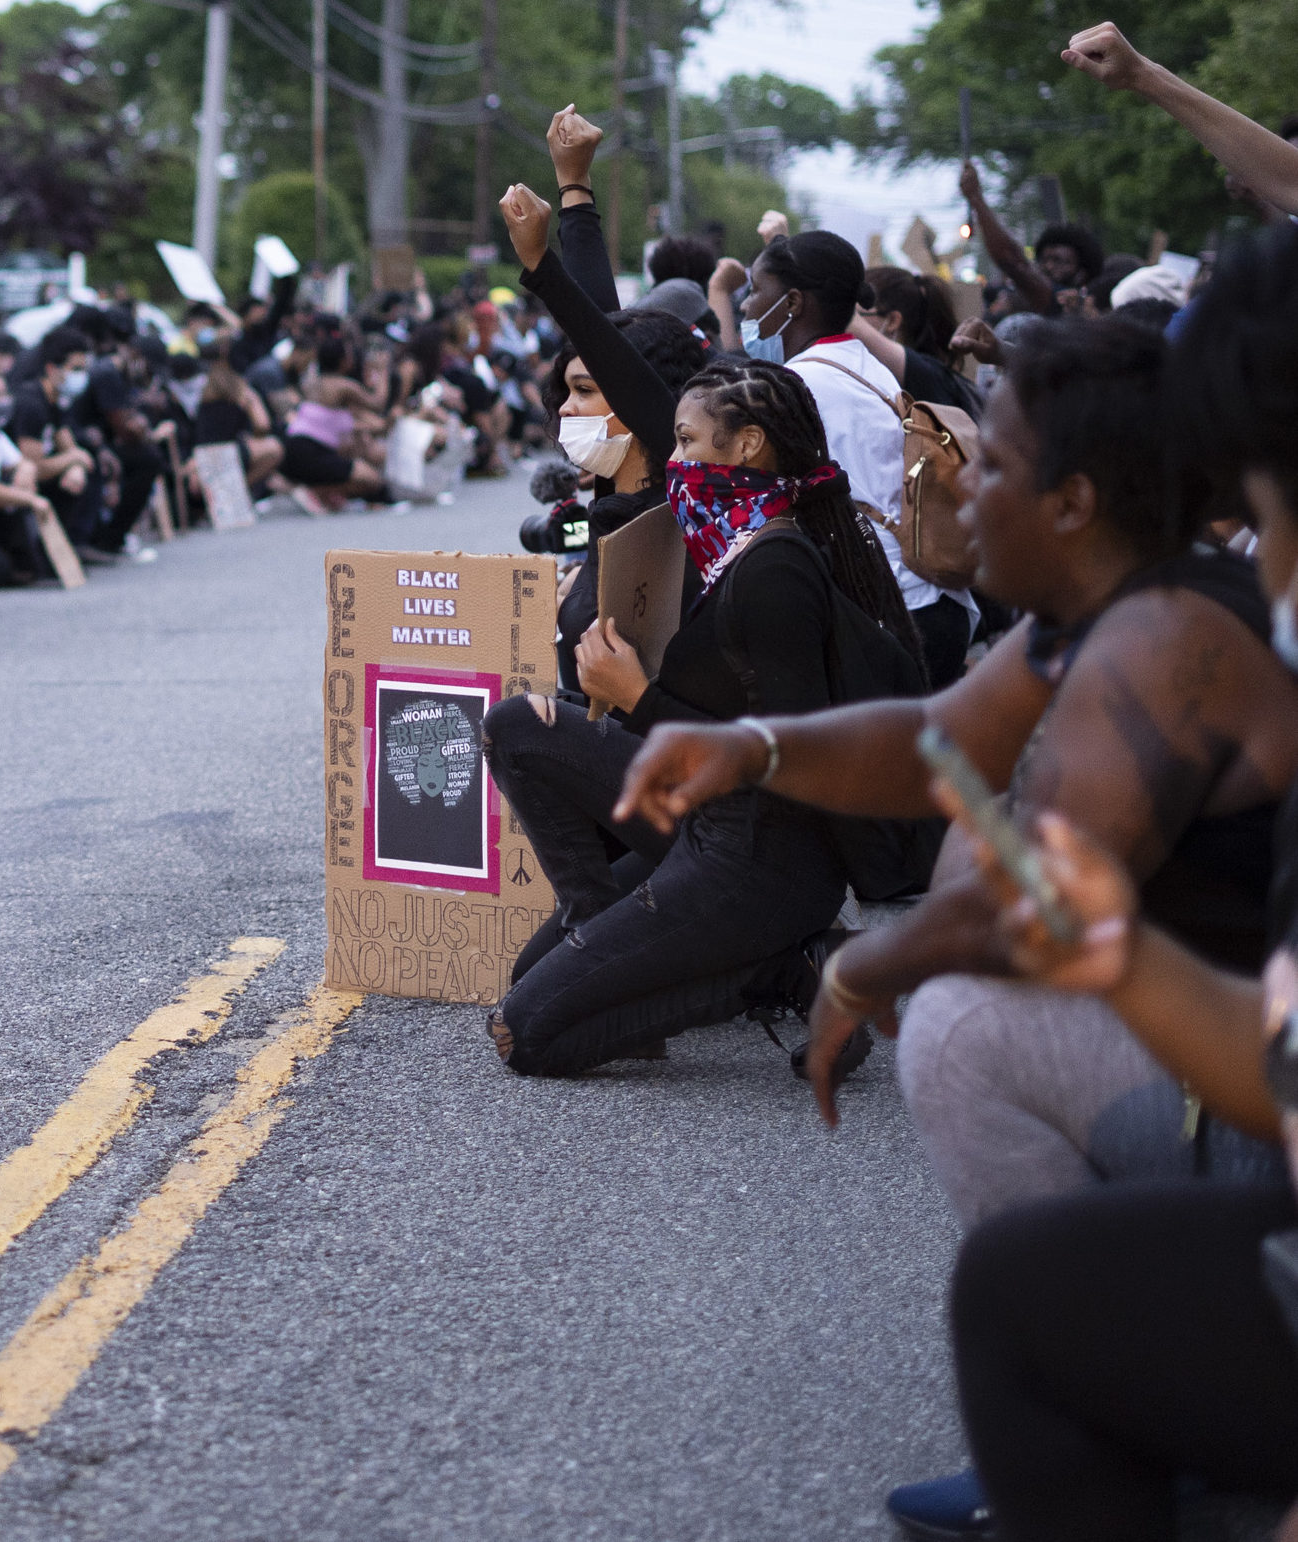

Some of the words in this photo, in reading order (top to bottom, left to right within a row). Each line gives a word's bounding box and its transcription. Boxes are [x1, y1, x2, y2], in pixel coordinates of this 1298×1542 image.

[398, 569, 459, 590] BLACK
[404, 598, 456, 617] LIVES
[392, 626, 471, 646] MATTER
[328, 563, 356, 867] GEORGE
[402, 708, 442, 722] WOMAN
[396, 719, 460, 745] BLACK
[391, 745, 419, 757] PROUD
[442, 743, 470, 756] GIFTED
[394, 773, 415, 781] GIFTED
[448, 770, 470, 779] STRONG
[447, 780, 469, 788] WOMAN
[443, 789, 461, 797] PROUD
[332, 887, 385, 938] NO
[332, 935, 386, 989] NO
